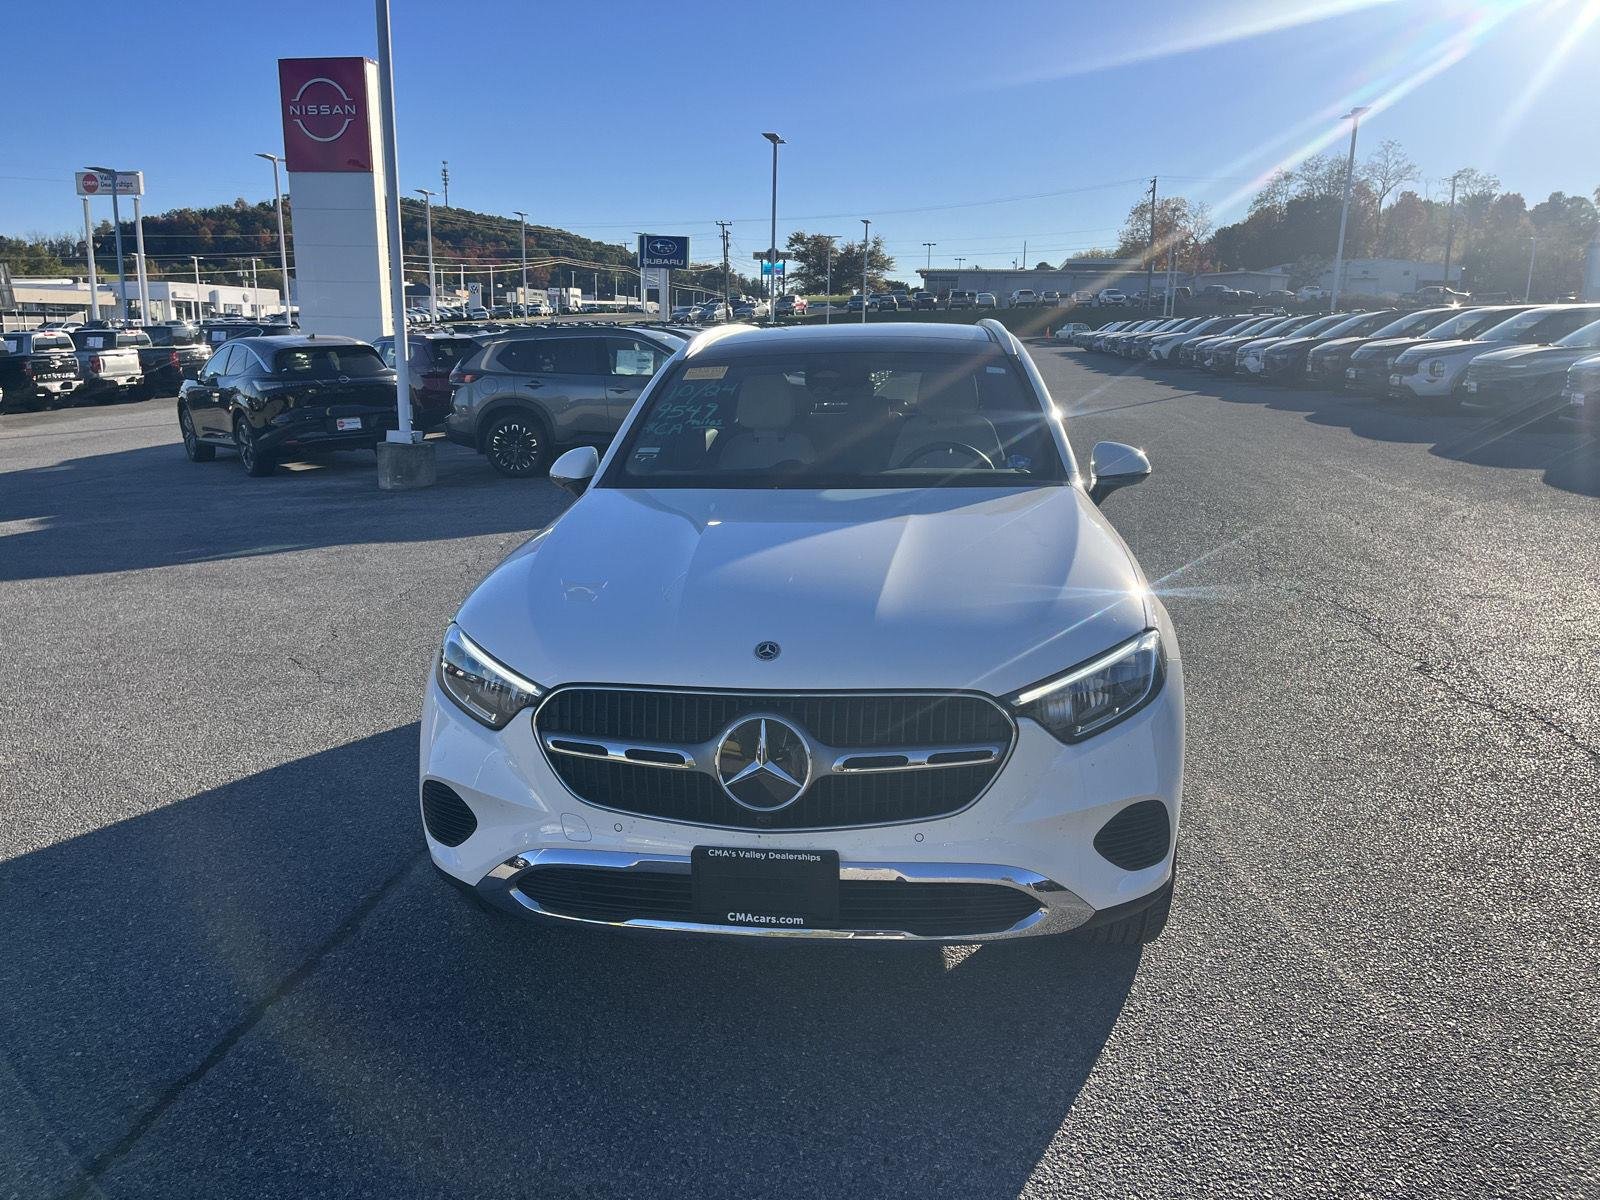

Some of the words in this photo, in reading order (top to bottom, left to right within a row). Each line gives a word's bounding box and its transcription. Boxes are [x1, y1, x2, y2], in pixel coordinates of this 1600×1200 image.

[289, 105, 356, 115] NISSAN
[642, 258, 684, 266] SUBARU
[708, 849, 737, 858] CMA's
[738, 850, 766, 860] Valley
[768, 852, 821, 862] Dealerships
[727, 912, 804, 925] CMAcars.com
